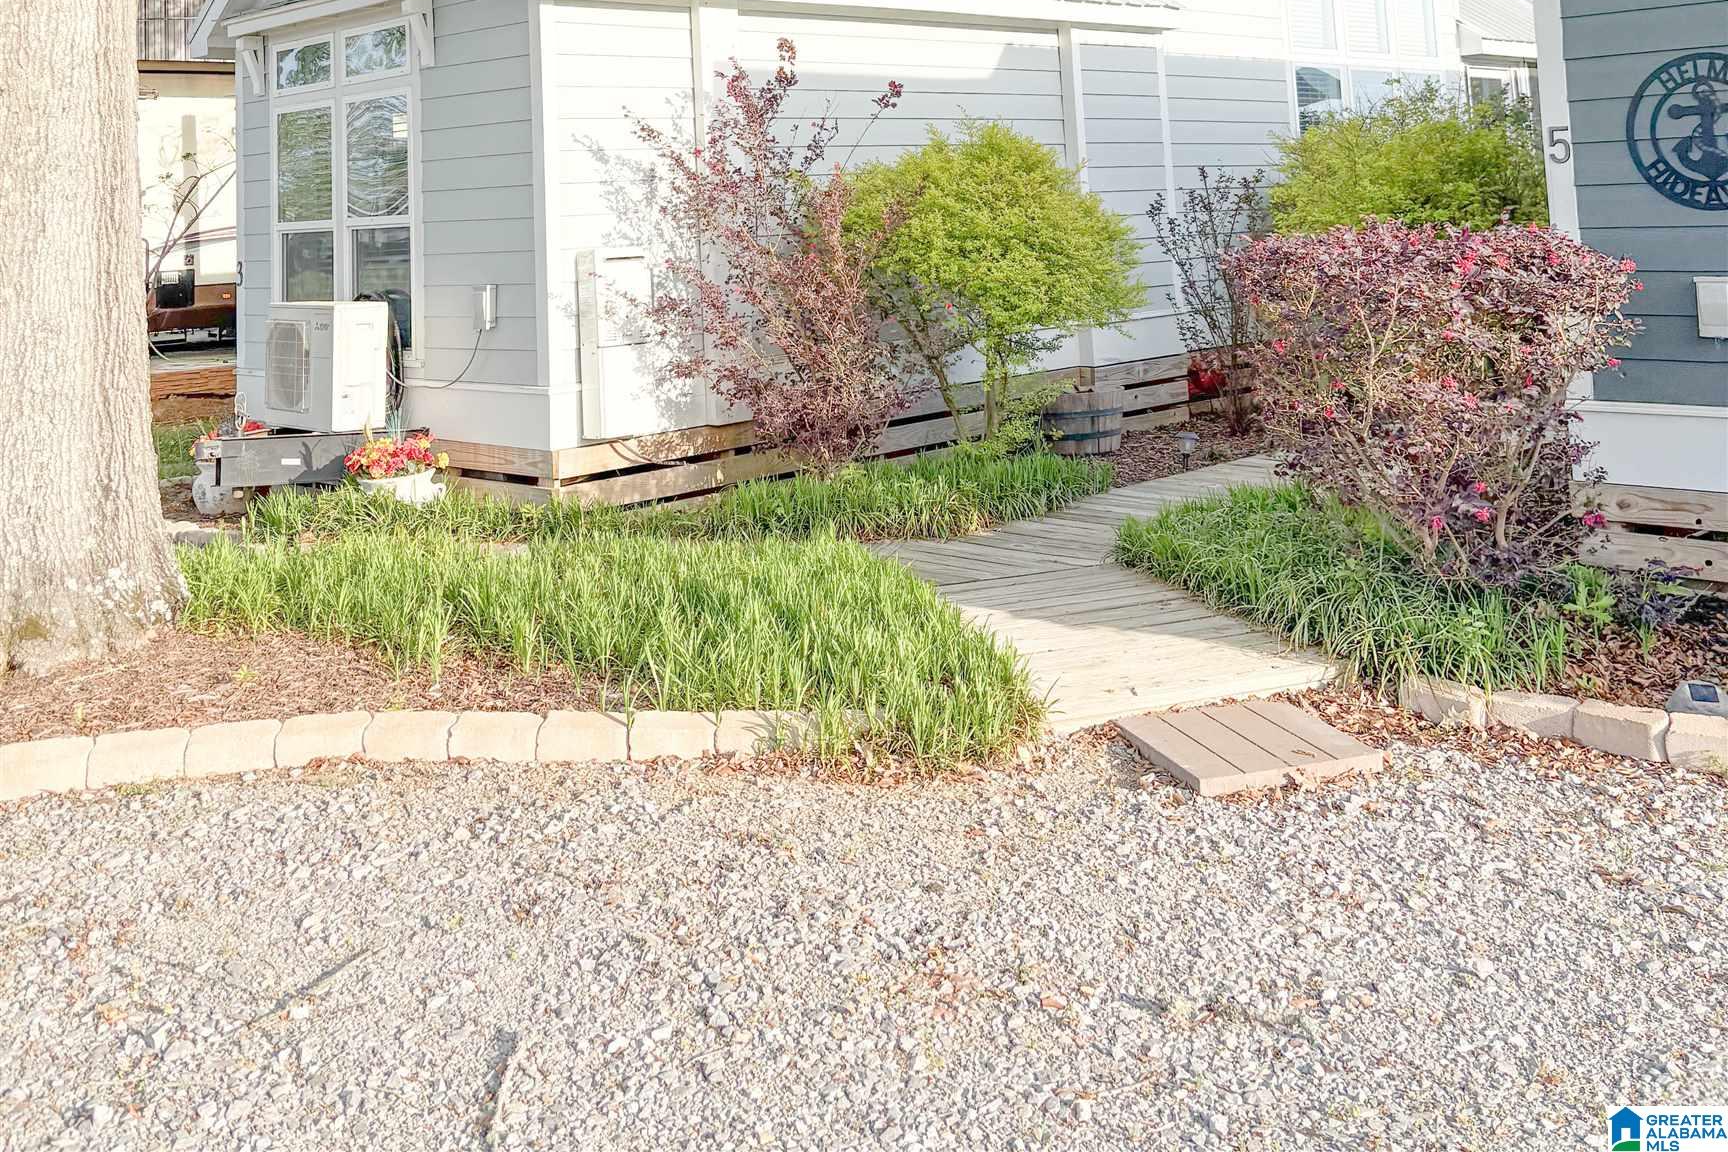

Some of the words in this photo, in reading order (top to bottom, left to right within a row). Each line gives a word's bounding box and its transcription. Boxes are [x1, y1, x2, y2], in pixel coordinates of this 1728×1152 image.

[1549, 126, 1570, 164] 5
[1645, 158, 1728, 208] HIDEA
[236, 261, 243, 287] 3
